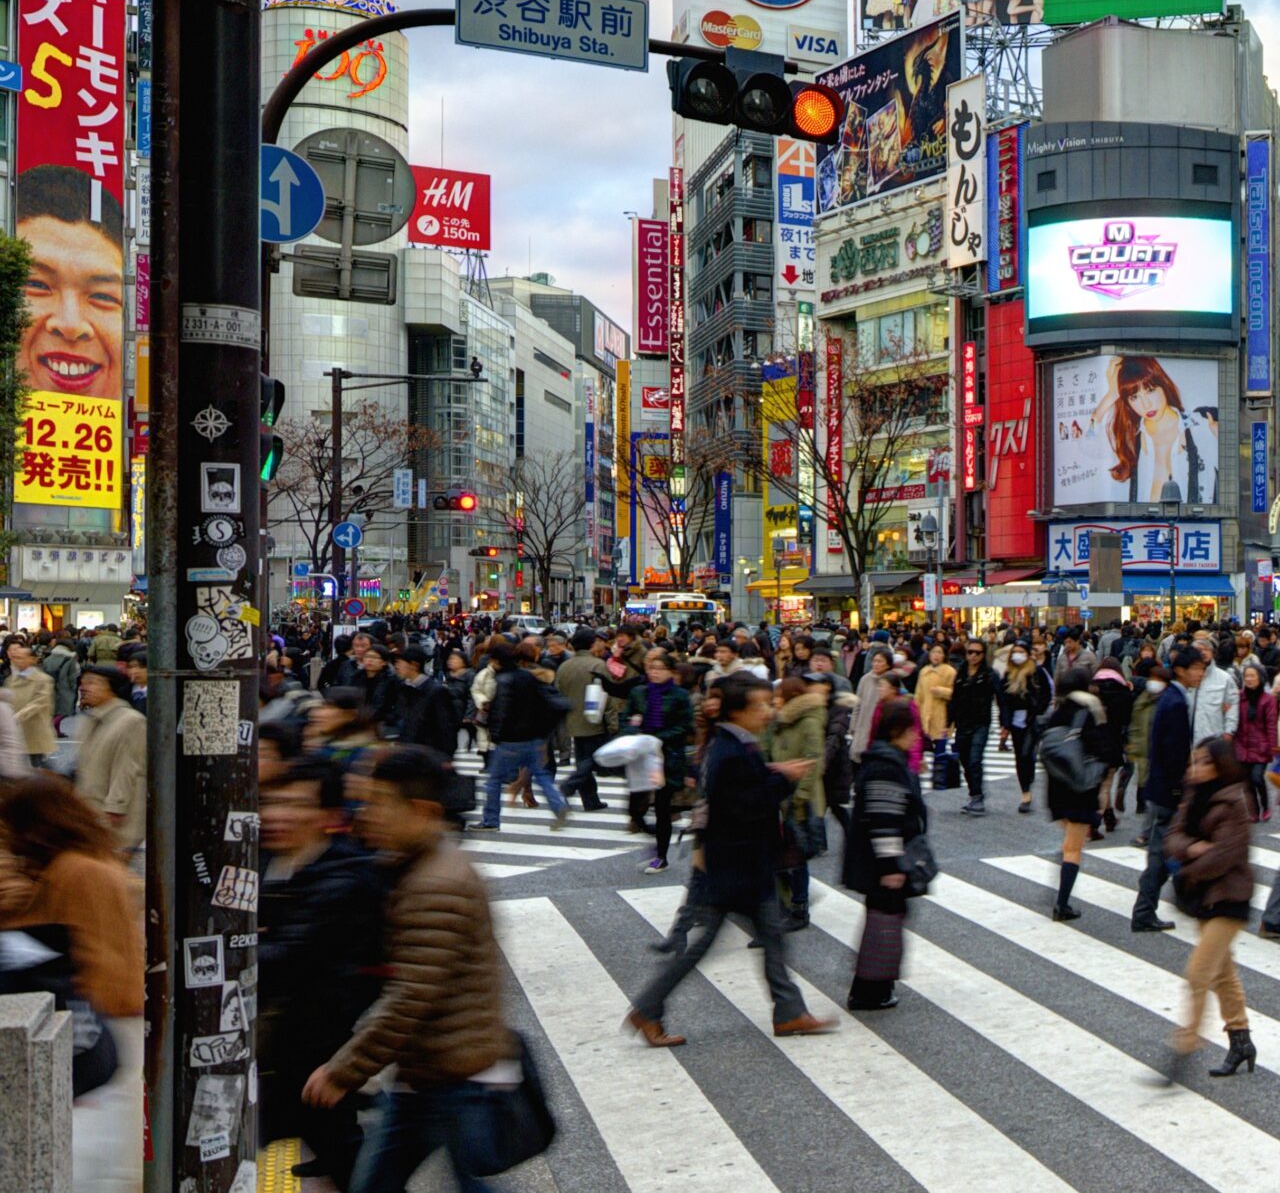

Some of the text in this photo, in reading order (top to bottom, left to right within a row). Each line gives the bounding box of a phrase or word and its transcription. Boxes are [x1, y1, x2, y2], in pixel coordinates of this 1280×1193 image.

[498, 23, 615, 57] Shibuya Sta.
[702, 20, 763, 40] MasterCard
[794, 34, 839, 56] VISA
[25, 42, 73, 109] 5
[1027, 136, 1124, 155] Mighty Vision SHIBUYA
[422, 177, 474, 211] H&M
[951, 98, 982, 258] もんじゃ
[442, 218, 471, 228] この先
[442, 229, 481, 241] 150m
[1249, 168, 1266, 331] Taisei neon
[640, 223, 663, 348] Essential
[1080, 267, 1165, 286] DOWN
[21, 397, 115, 419] ニューアルバム
[22, 417, 113, 453] 12.26
[22, 451, 114, 492] 発売!!
[1254, 428, 1265, 507] 大盛堂商事ビル
